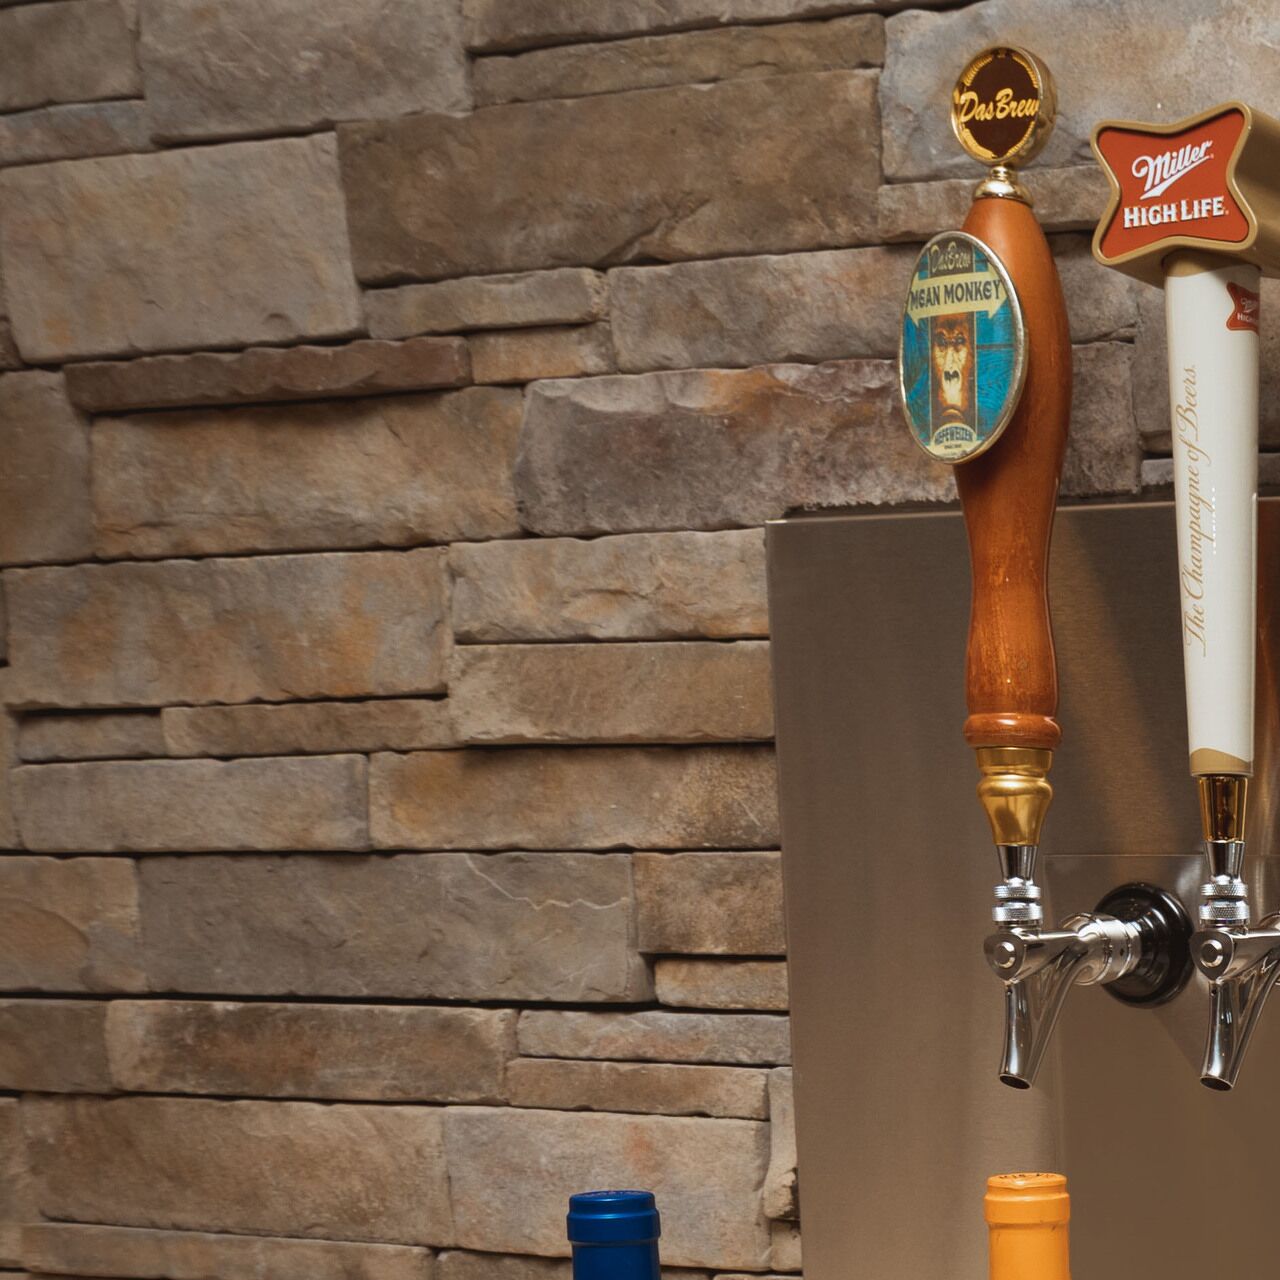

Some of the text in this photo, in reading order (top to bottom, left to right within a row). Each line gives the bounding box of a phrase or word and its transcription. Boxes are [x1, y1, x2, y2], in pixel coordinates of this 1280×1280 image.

[1131, 140, 1213, 200] Miller
[1123, 196, 1225, 229] HIGH LIFE
[909, 280, 1001, 311] MEAN MONKEY
[1178, 434, 1211, 467] of
[1182, 465, 1215, 600] Champagne
[1184, 604, 1206, 657] The
